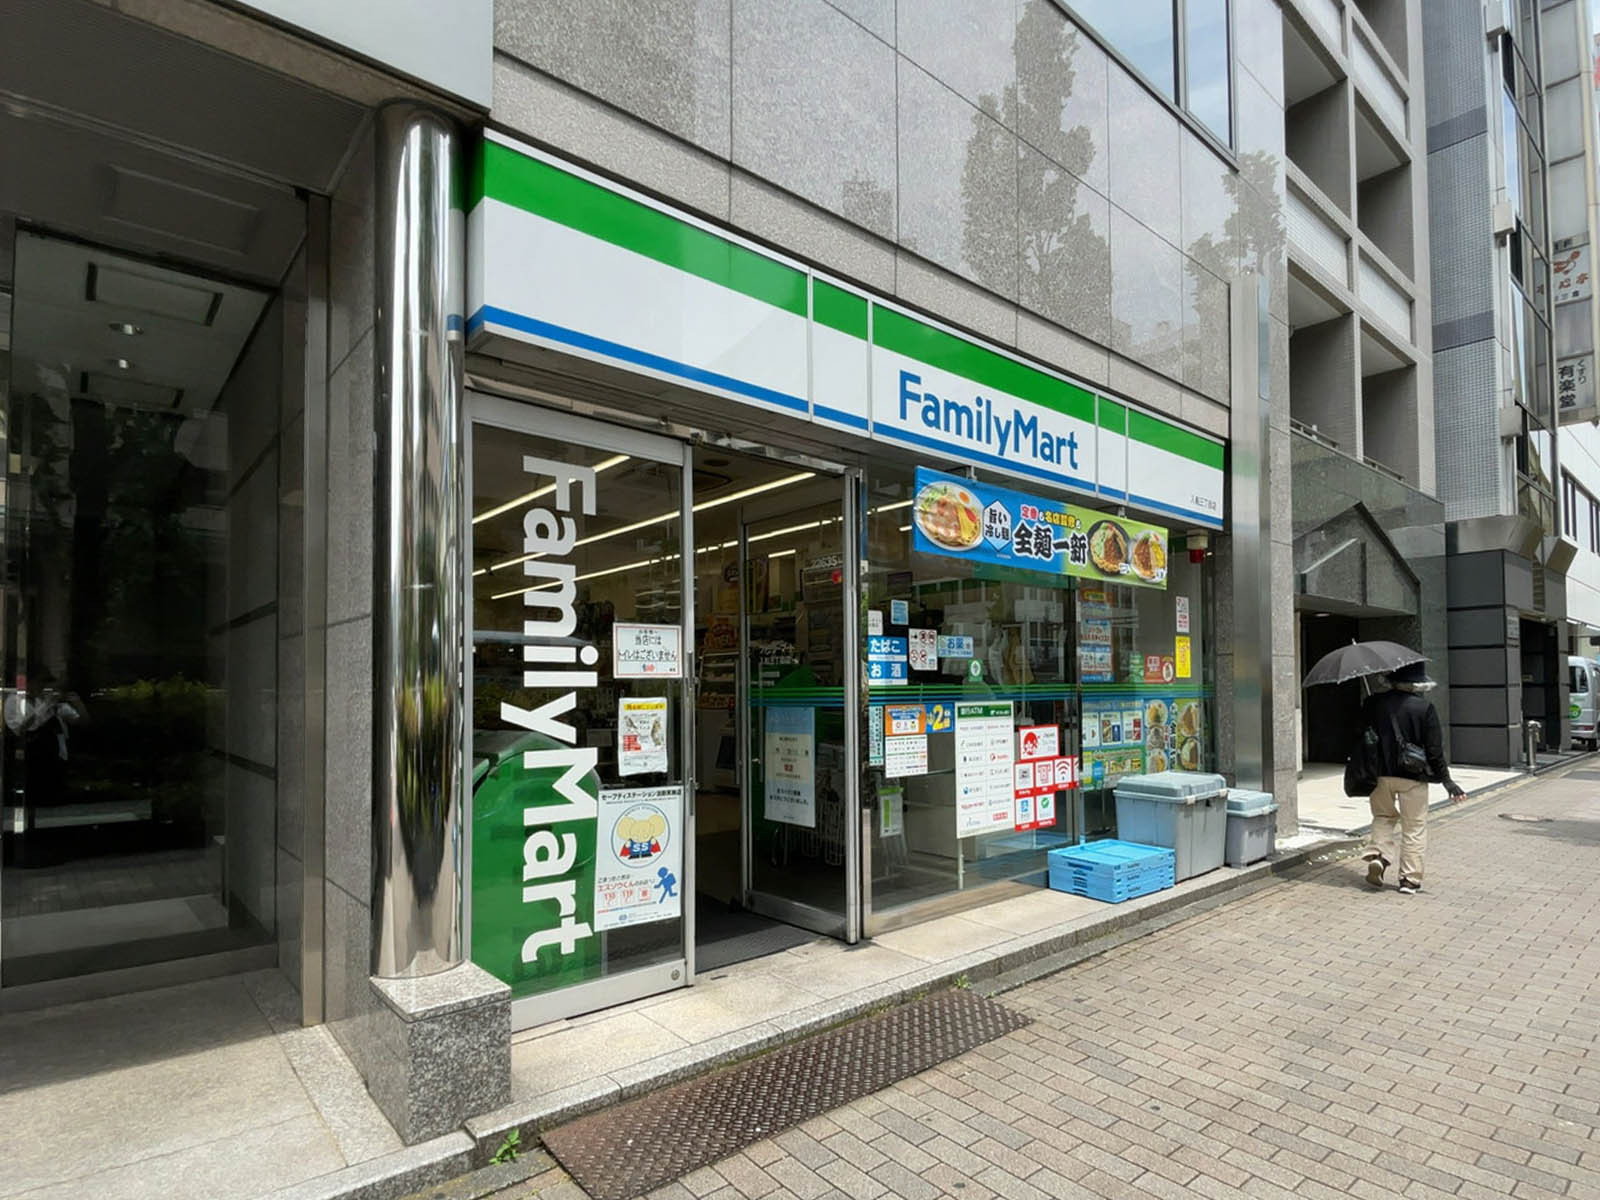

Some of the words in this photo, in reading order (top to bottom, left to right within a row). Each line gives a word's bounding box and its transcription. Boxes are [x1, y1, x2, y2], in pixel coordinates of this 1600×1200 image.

[1577, 359, 1586, 384] くすり
[1558, 365, 1576, 408] 有楽堂
[899, 369, 1078, 470] FamilyMart
[989, 508, 1008, 525] 旨い
[1012, 519, 1088, 567] 全麺一新
[634, 635, 662, 646] 当店には
[870, 638, 901, 653] たばこ
[617, 648, 678, 662] トイレはございません
[870, 663, 902, 678] お酒
[500, 455, 598, 964] FamilyMart
[932, 703, 945, 731] 2
[632, 842, 649, 853] SS
